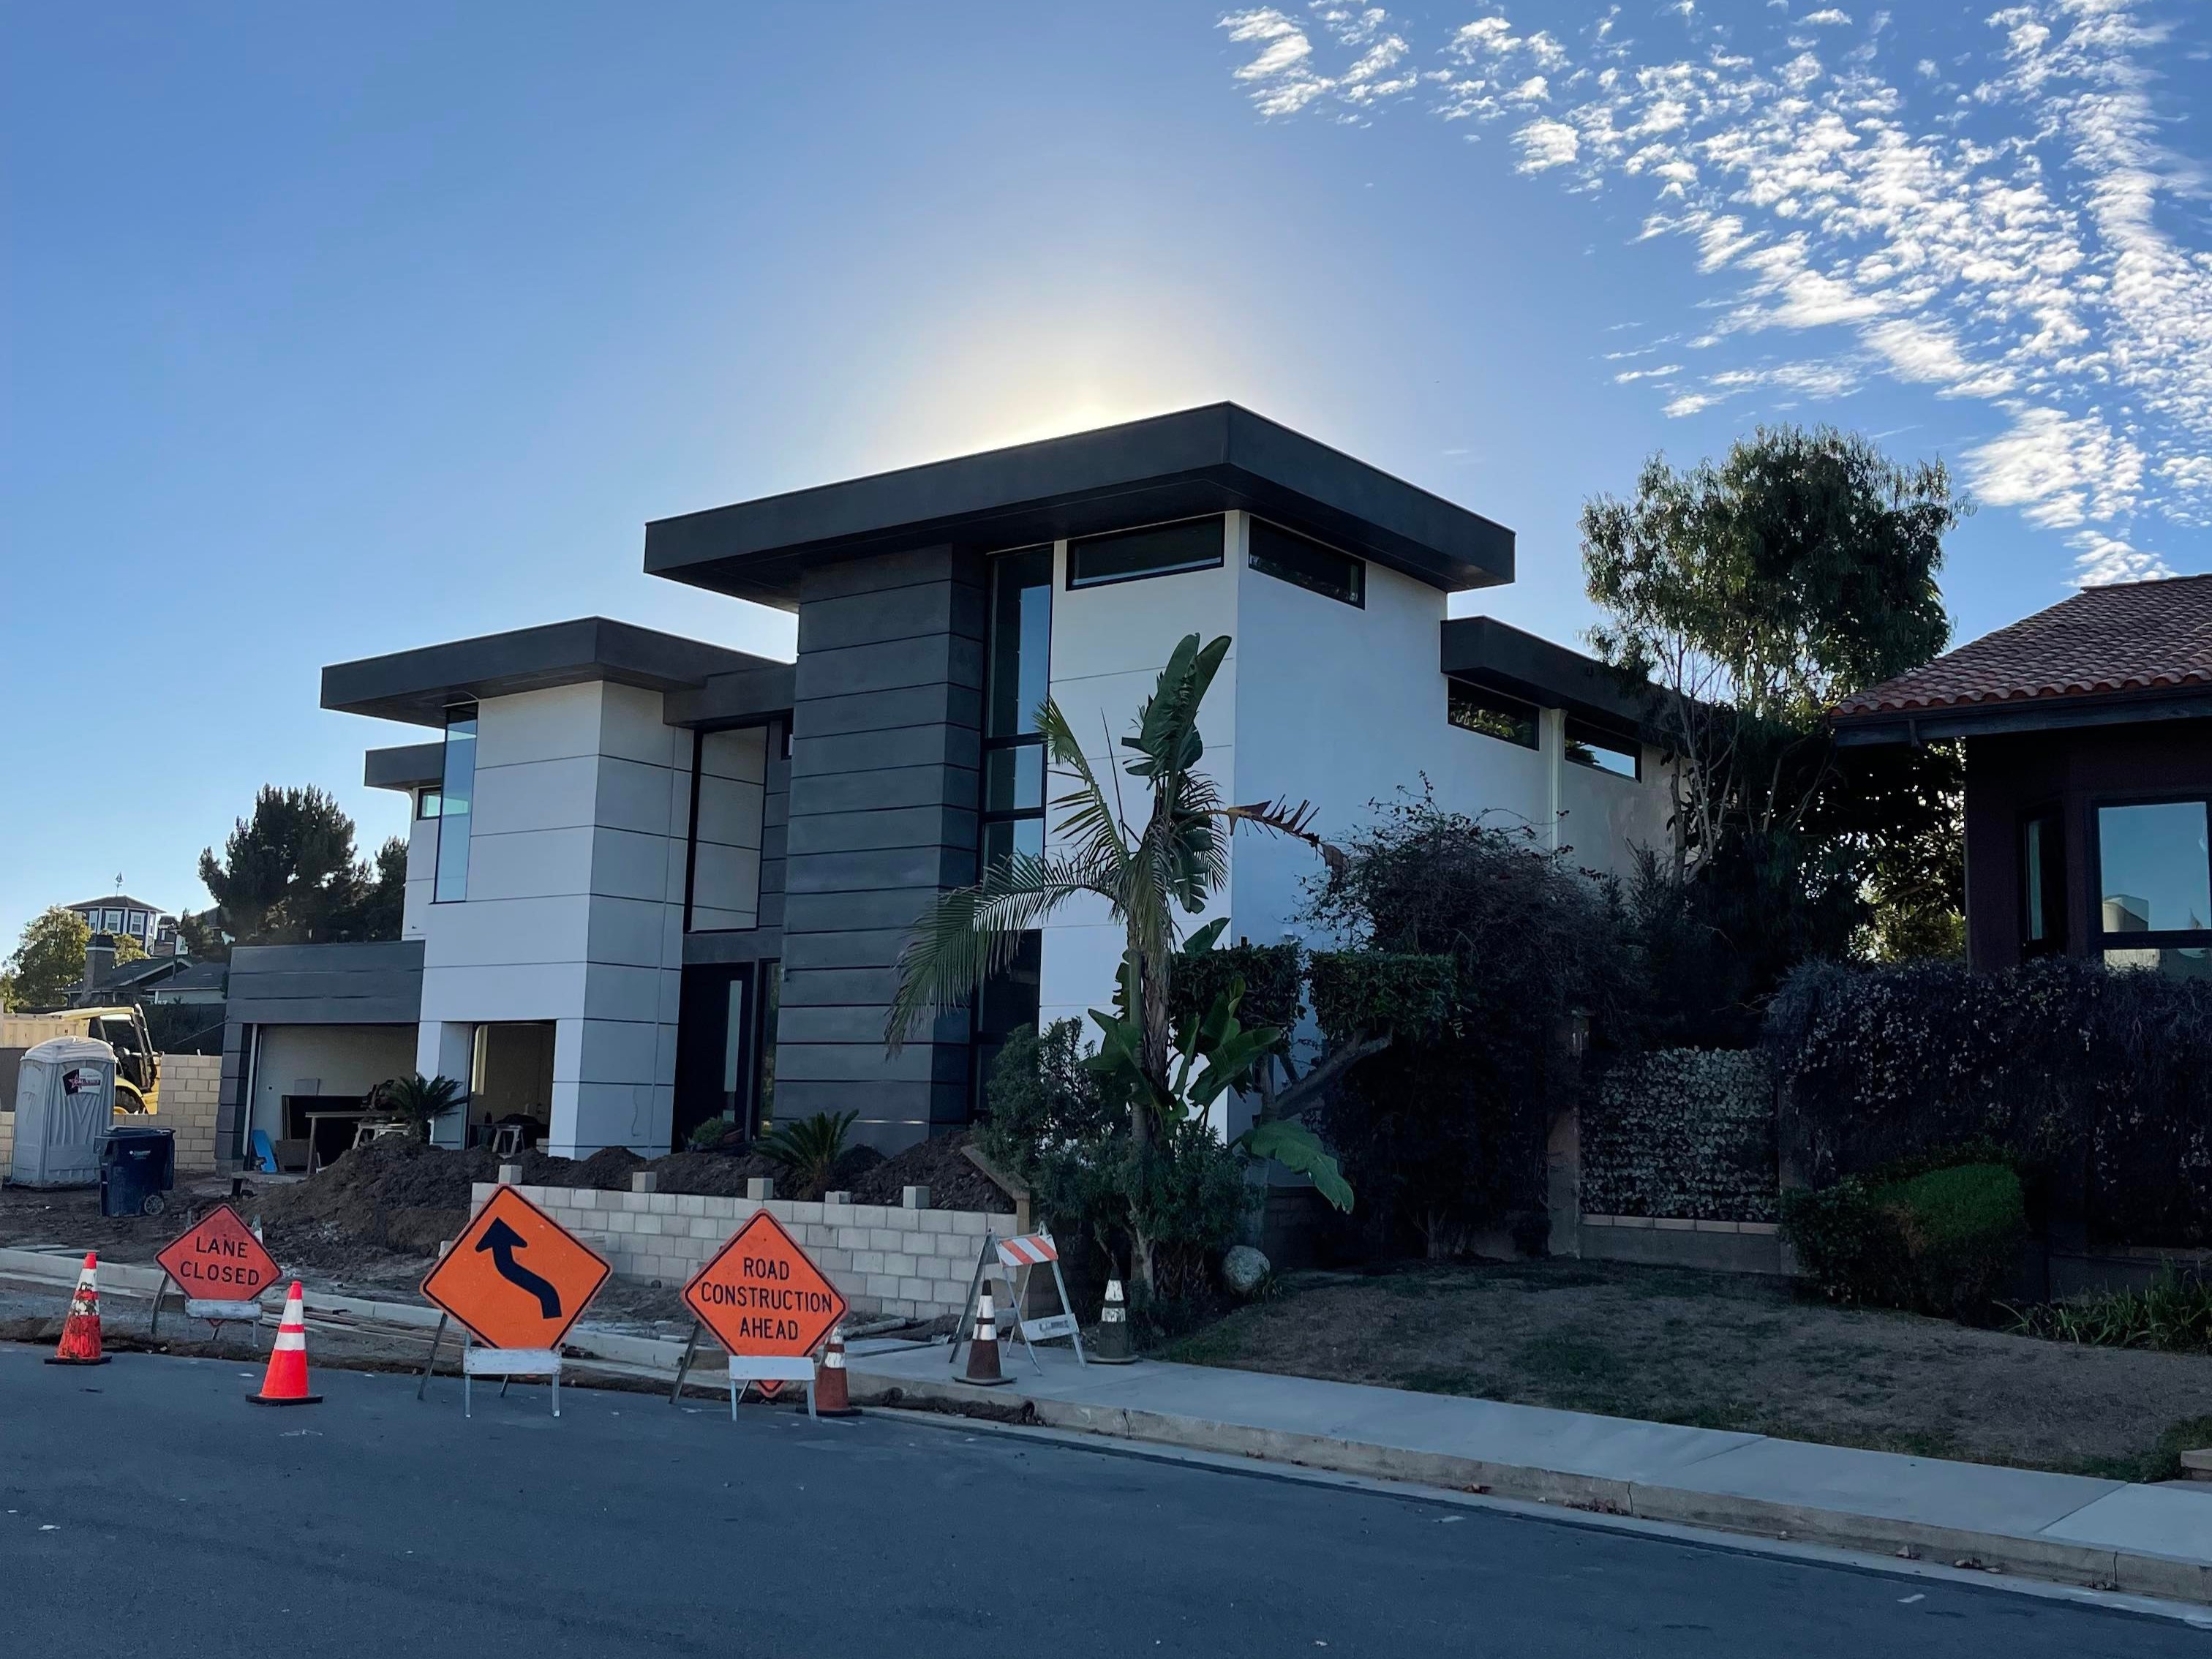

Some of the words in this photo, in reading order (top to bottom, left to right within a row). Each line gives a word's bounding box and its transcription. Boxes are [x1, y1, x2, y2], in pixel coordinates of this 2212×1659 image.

[196, 1236, 248, 1258] LANE
[180, 1260, 260, 1286] CLOSED
[743, 1257, 790, 1280] ROAD
[701, 1282, 832, 1314] CONSTRUCTION
[740, 1316, 799, 1340] AHEAD
